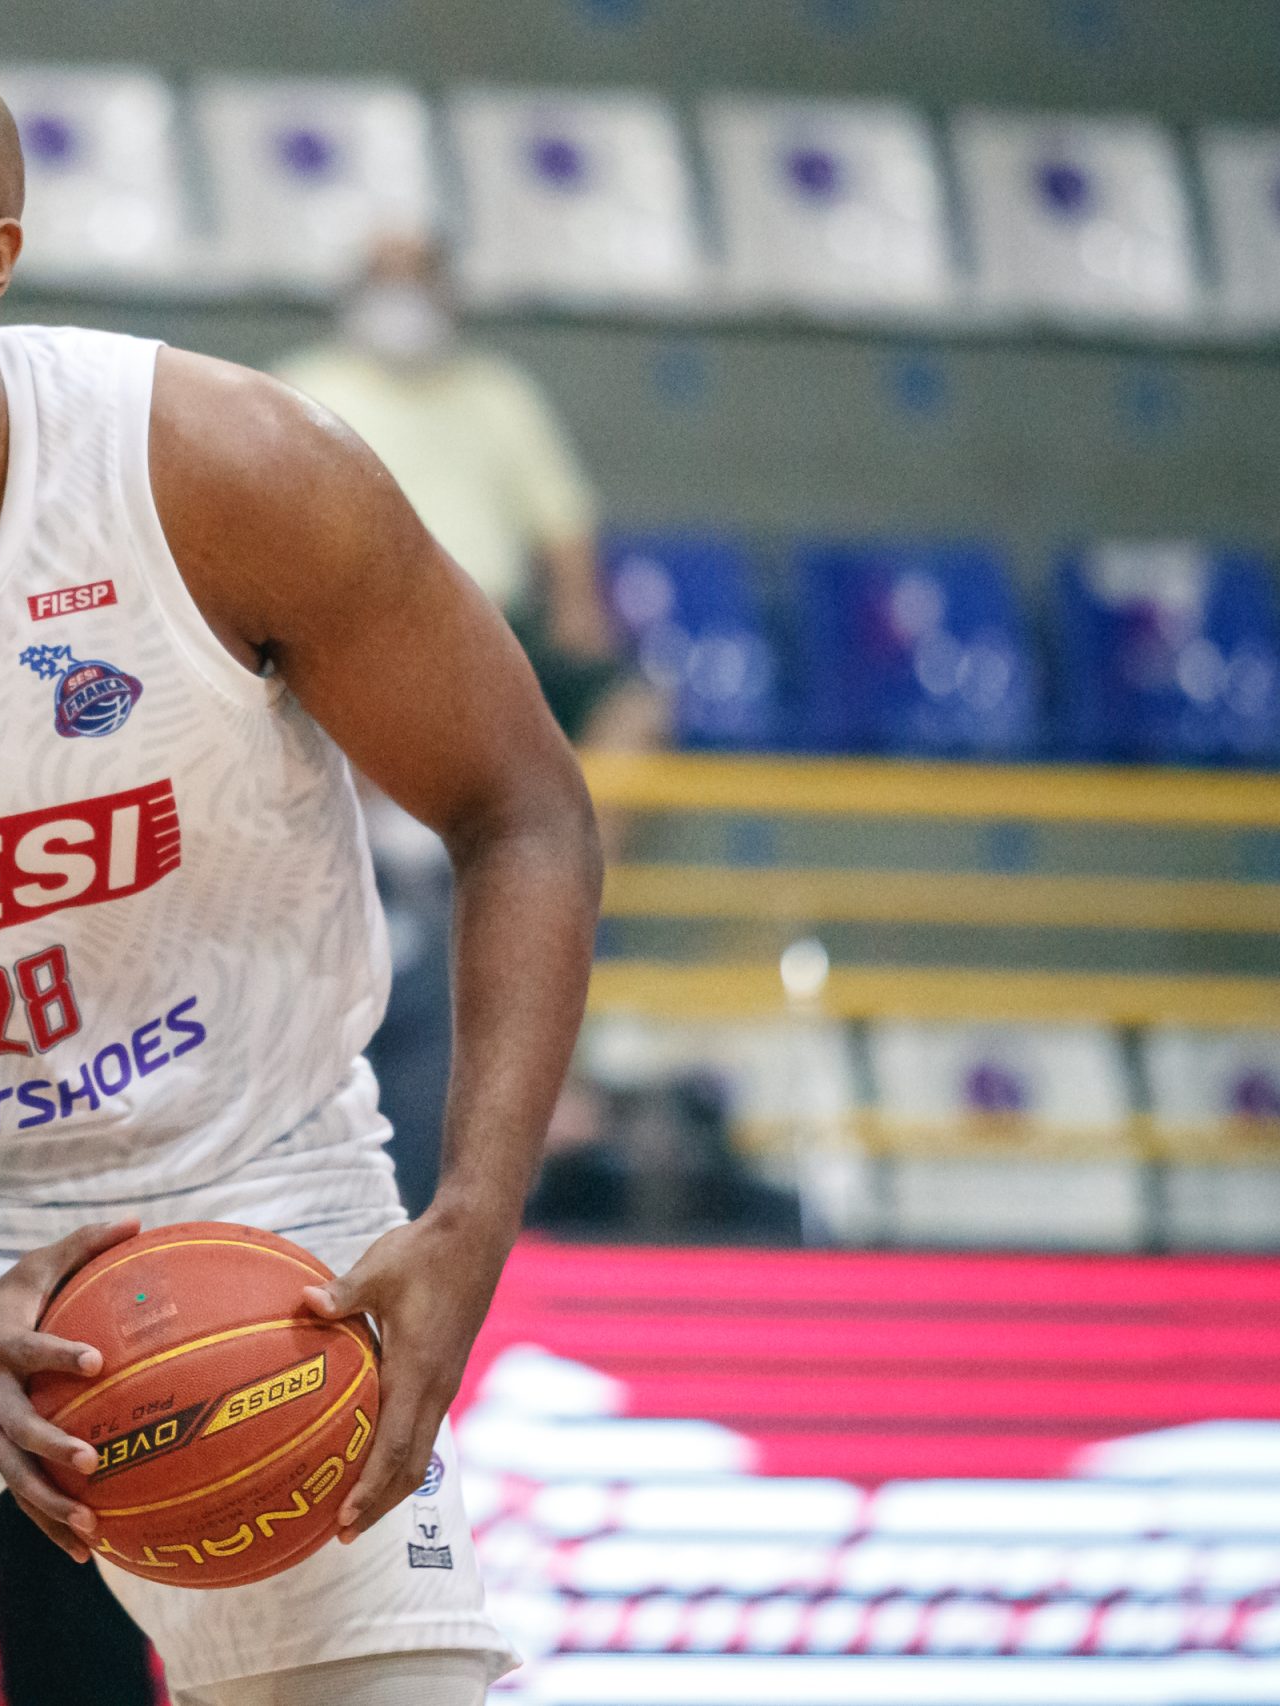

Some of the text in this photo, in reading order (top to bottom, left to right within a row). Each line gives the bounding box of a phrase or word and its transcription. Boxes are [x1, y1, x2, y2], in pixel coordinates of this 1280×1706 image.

[36, 584, 109, 617] FIESP
[68, 668, 98, 691] SESI
[64, 678, 131, 720] FRANCA
[96, 1366, 320, 1471] CROSS OVER
[132, 1393, 174, 1420] PRO
[96, 1408, 372, 1566] PENALTY
